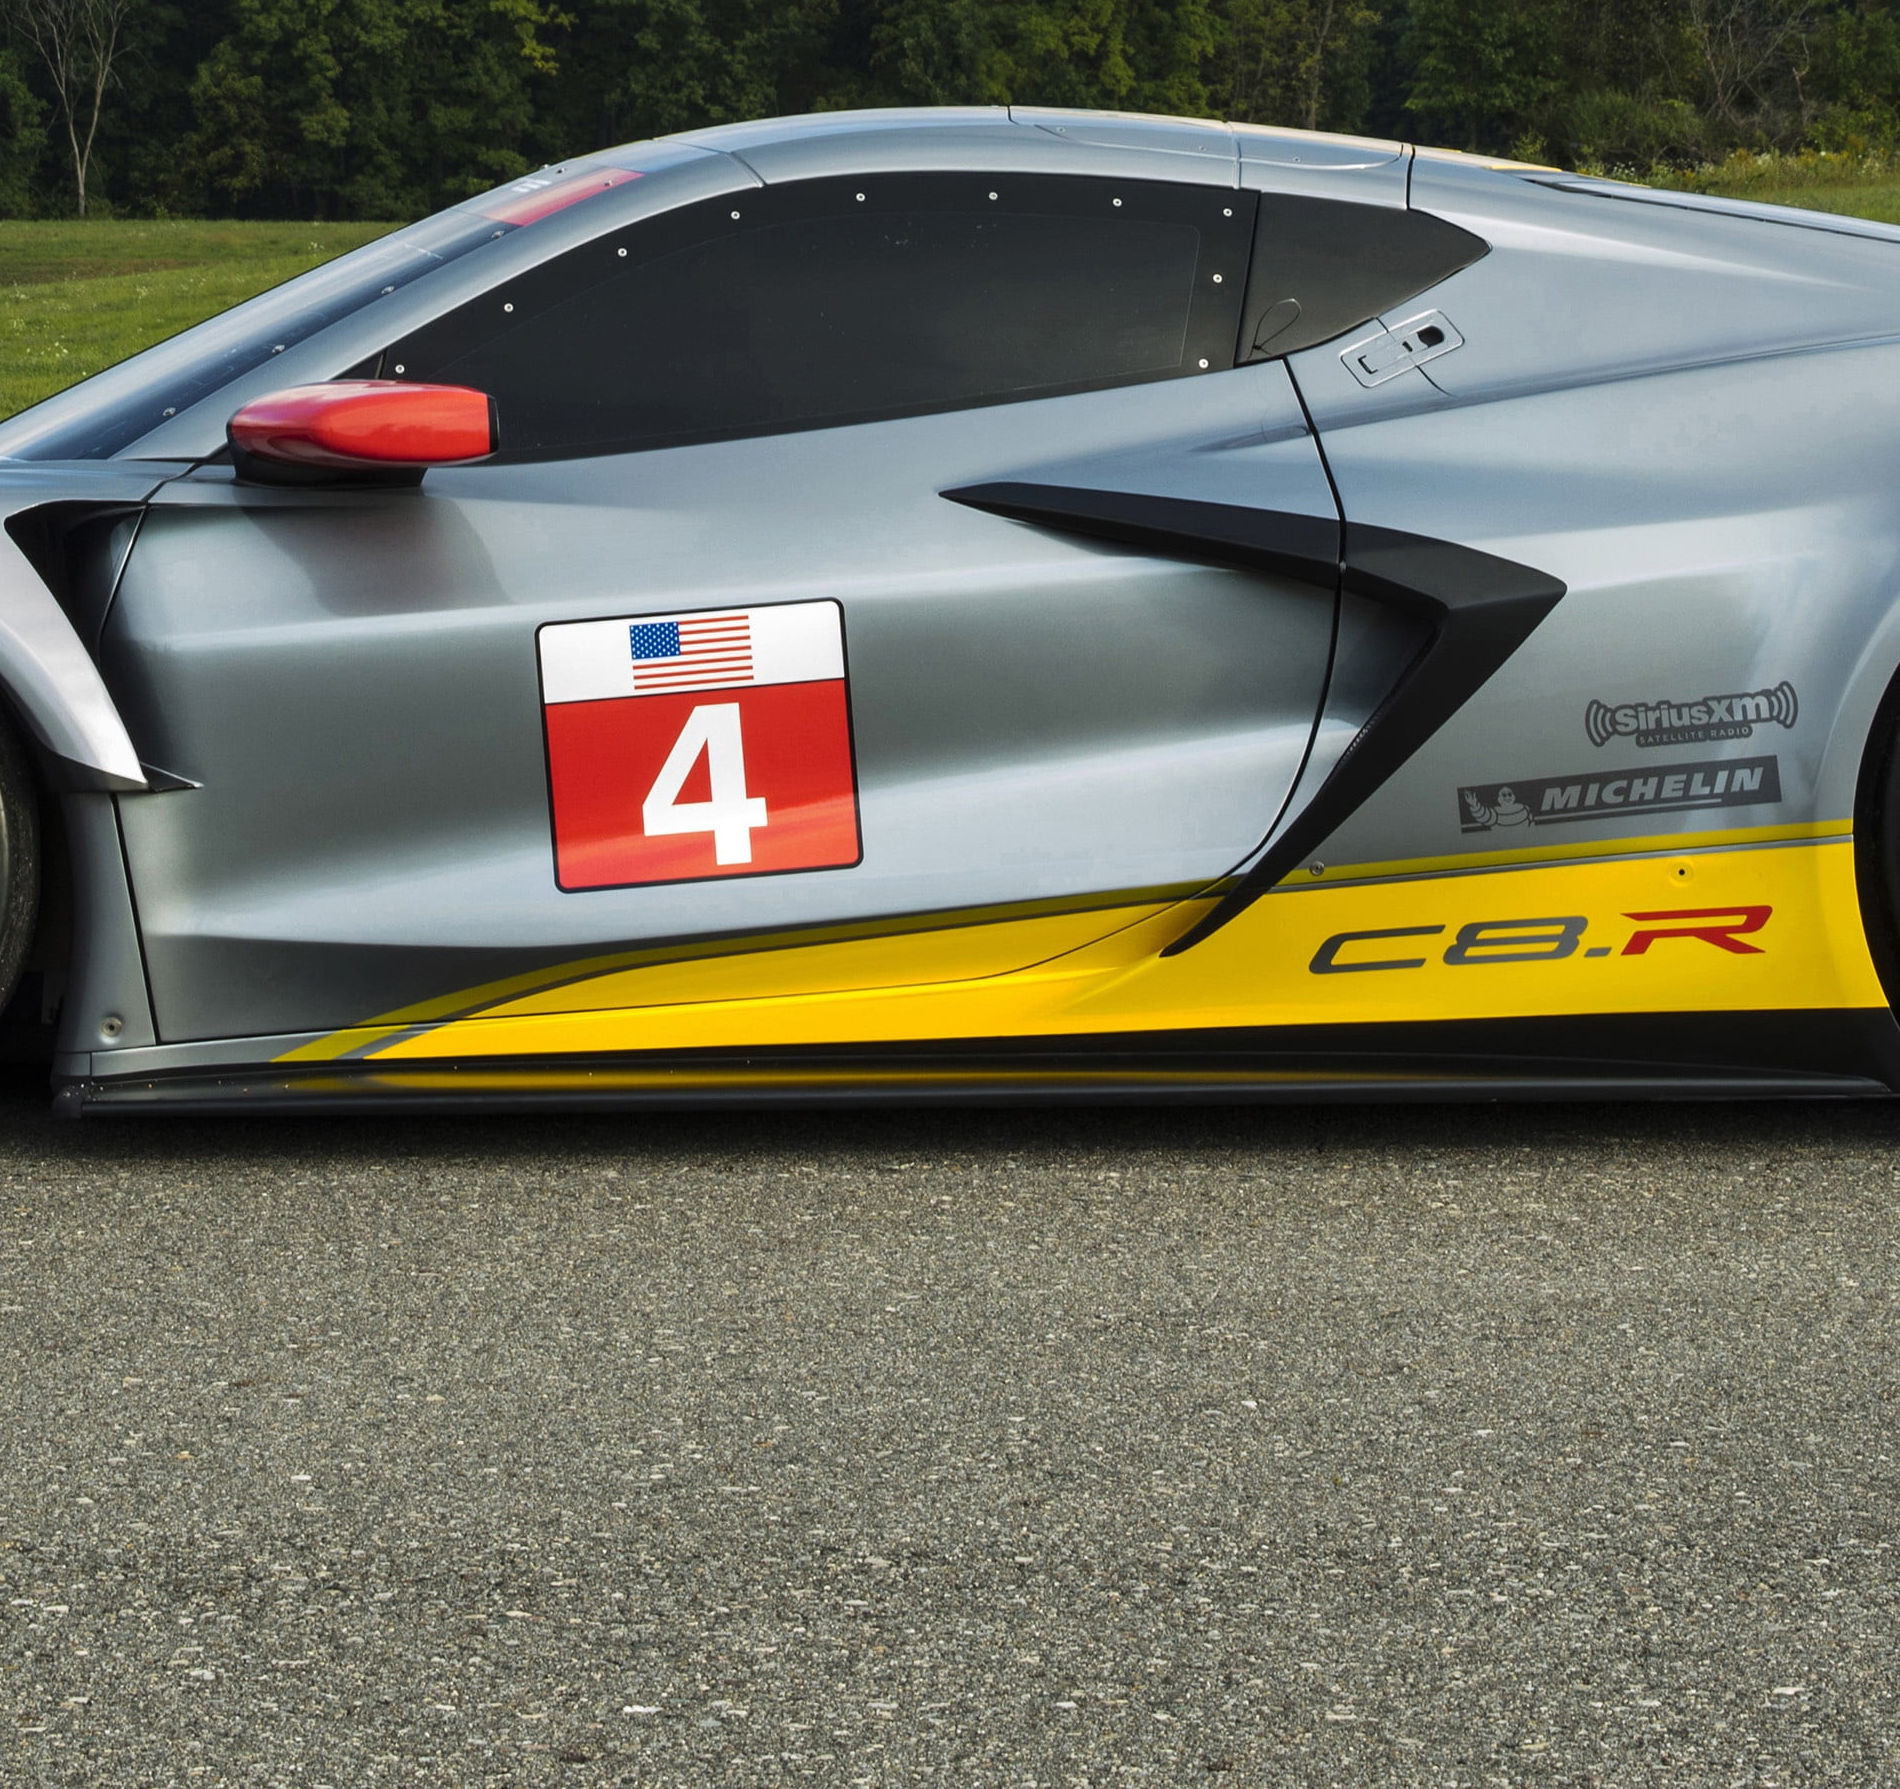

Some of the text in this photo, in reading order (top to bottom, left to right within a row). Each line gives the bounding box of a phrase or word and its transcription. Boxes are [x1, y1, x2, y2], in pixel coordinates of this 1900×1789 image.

[1638, 726, 1750, 745] SATELLITE RADIO
[641, 701, 768, 866] 4
[1540, 766, 1764, 811] MICHELIN
[1308, 905, 1773, 974] C8.R
